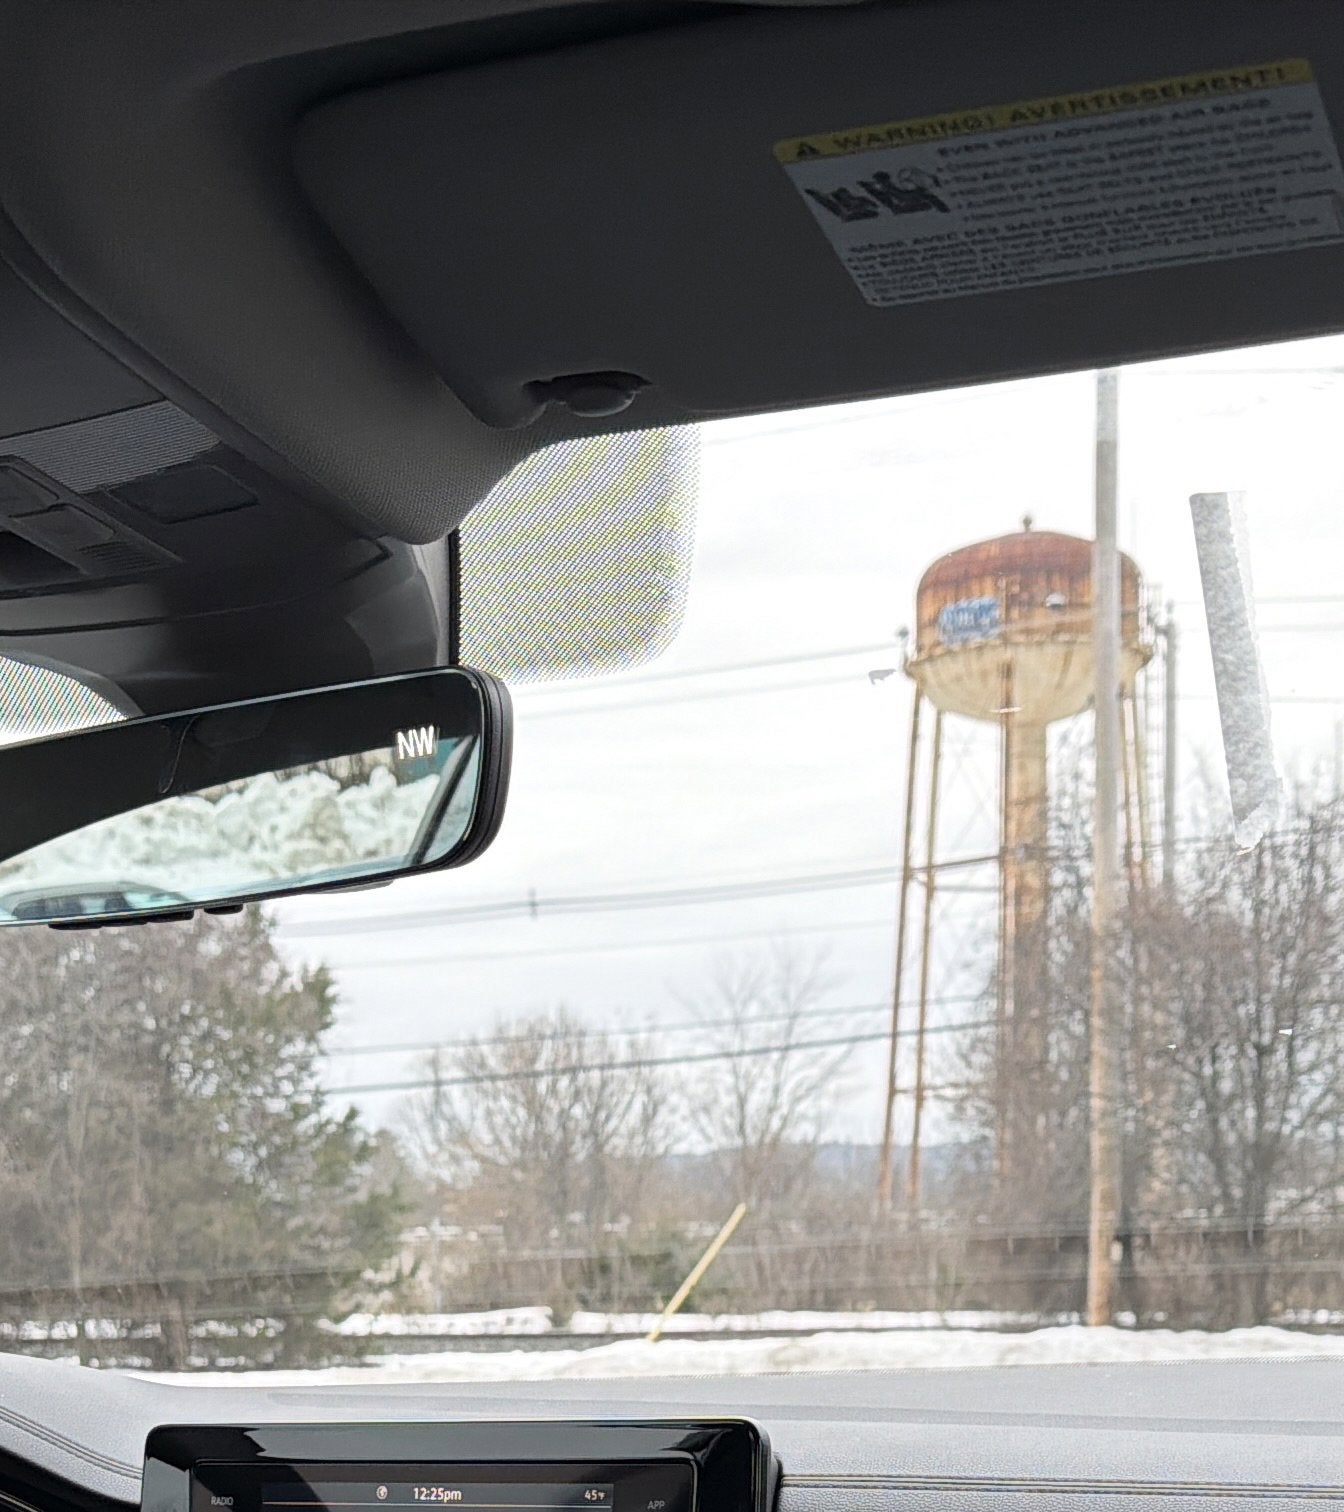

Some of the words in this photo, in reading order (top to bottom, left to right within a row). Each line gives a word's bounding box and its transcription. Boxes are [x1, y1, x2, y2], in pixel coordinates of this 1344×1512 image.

[833, 114, 995, 150] WARNING!
[1009, 67, 1285, 122] AVERTISSEMENT!
[397, 724, 435, 760] NW
[210, 1495, 234, 1506] RADIO
[413, 1486, 462, 1503] 12:25pm
[647, 1500, 665, 1511] APP
